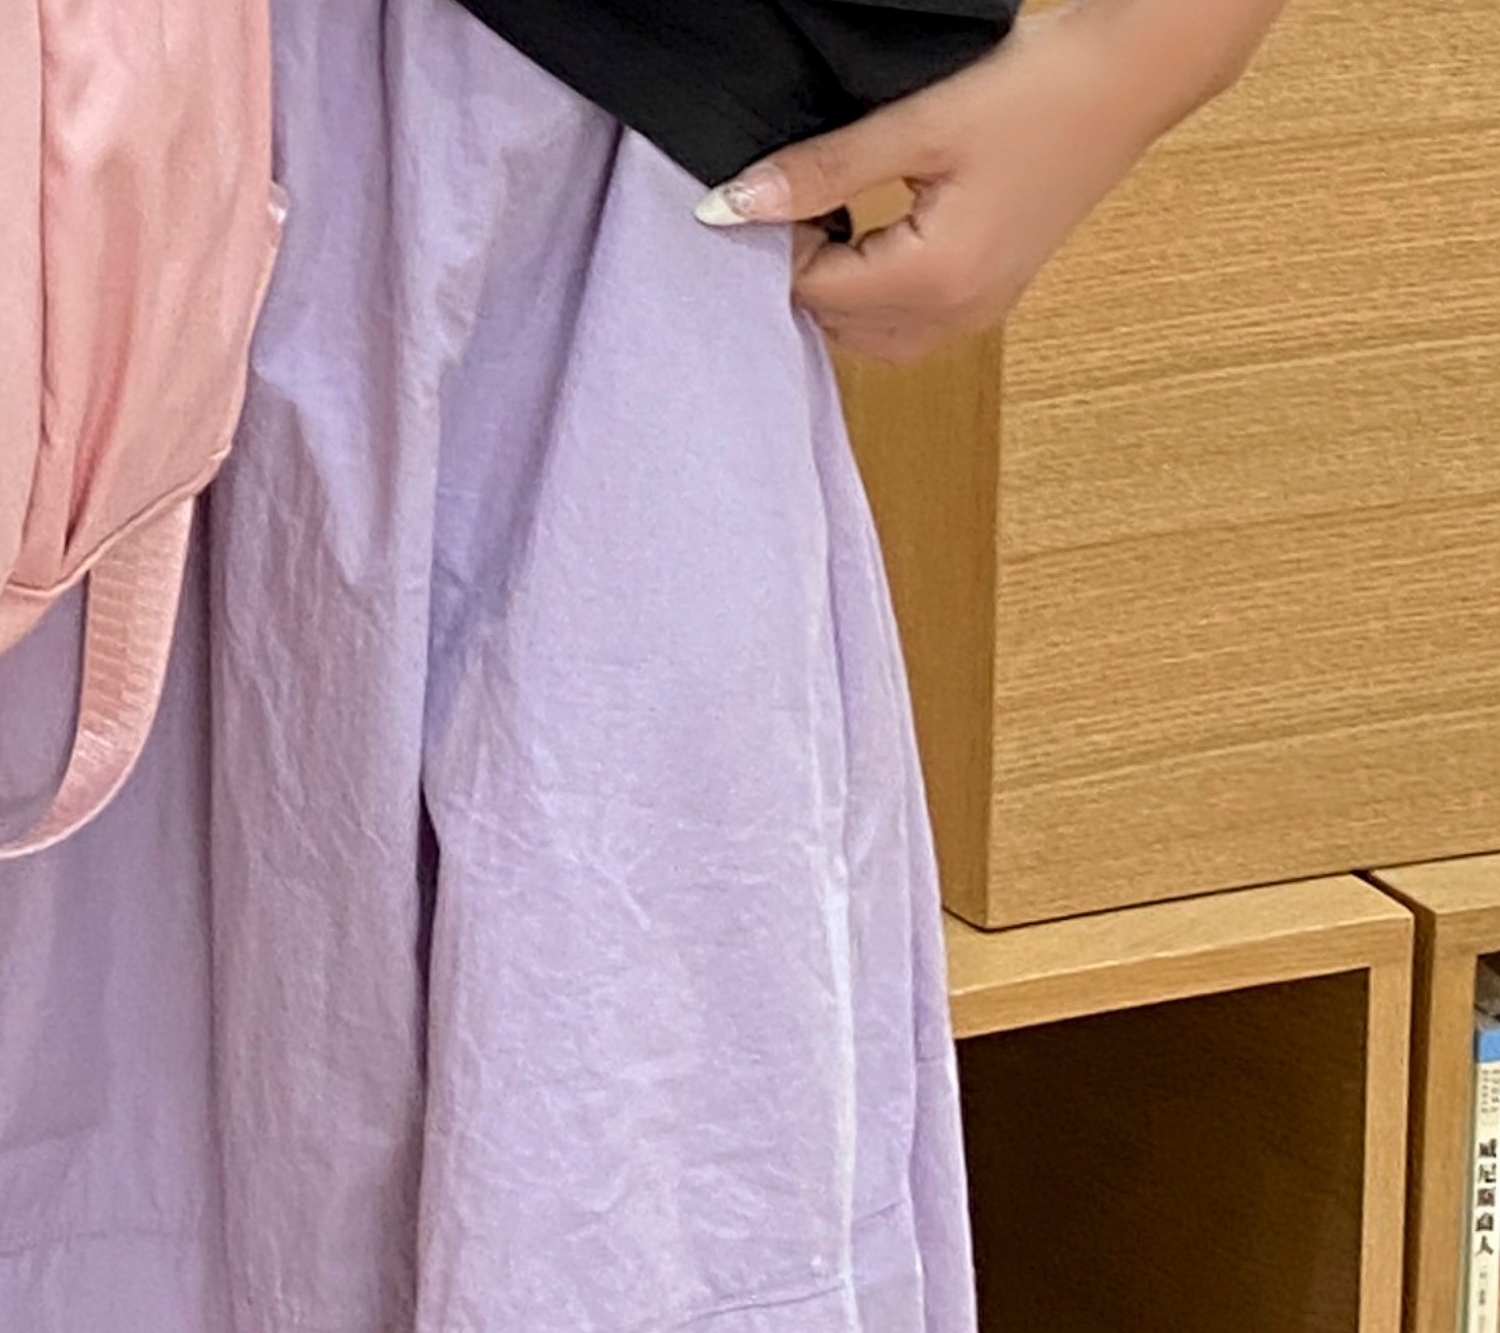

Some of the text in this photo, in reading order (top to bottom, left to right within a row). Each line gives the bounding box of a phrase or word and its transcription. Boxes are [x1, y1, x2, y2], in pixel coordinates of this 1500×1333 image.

[1475, 1138, 1497, 1257] 威尼斯商人
